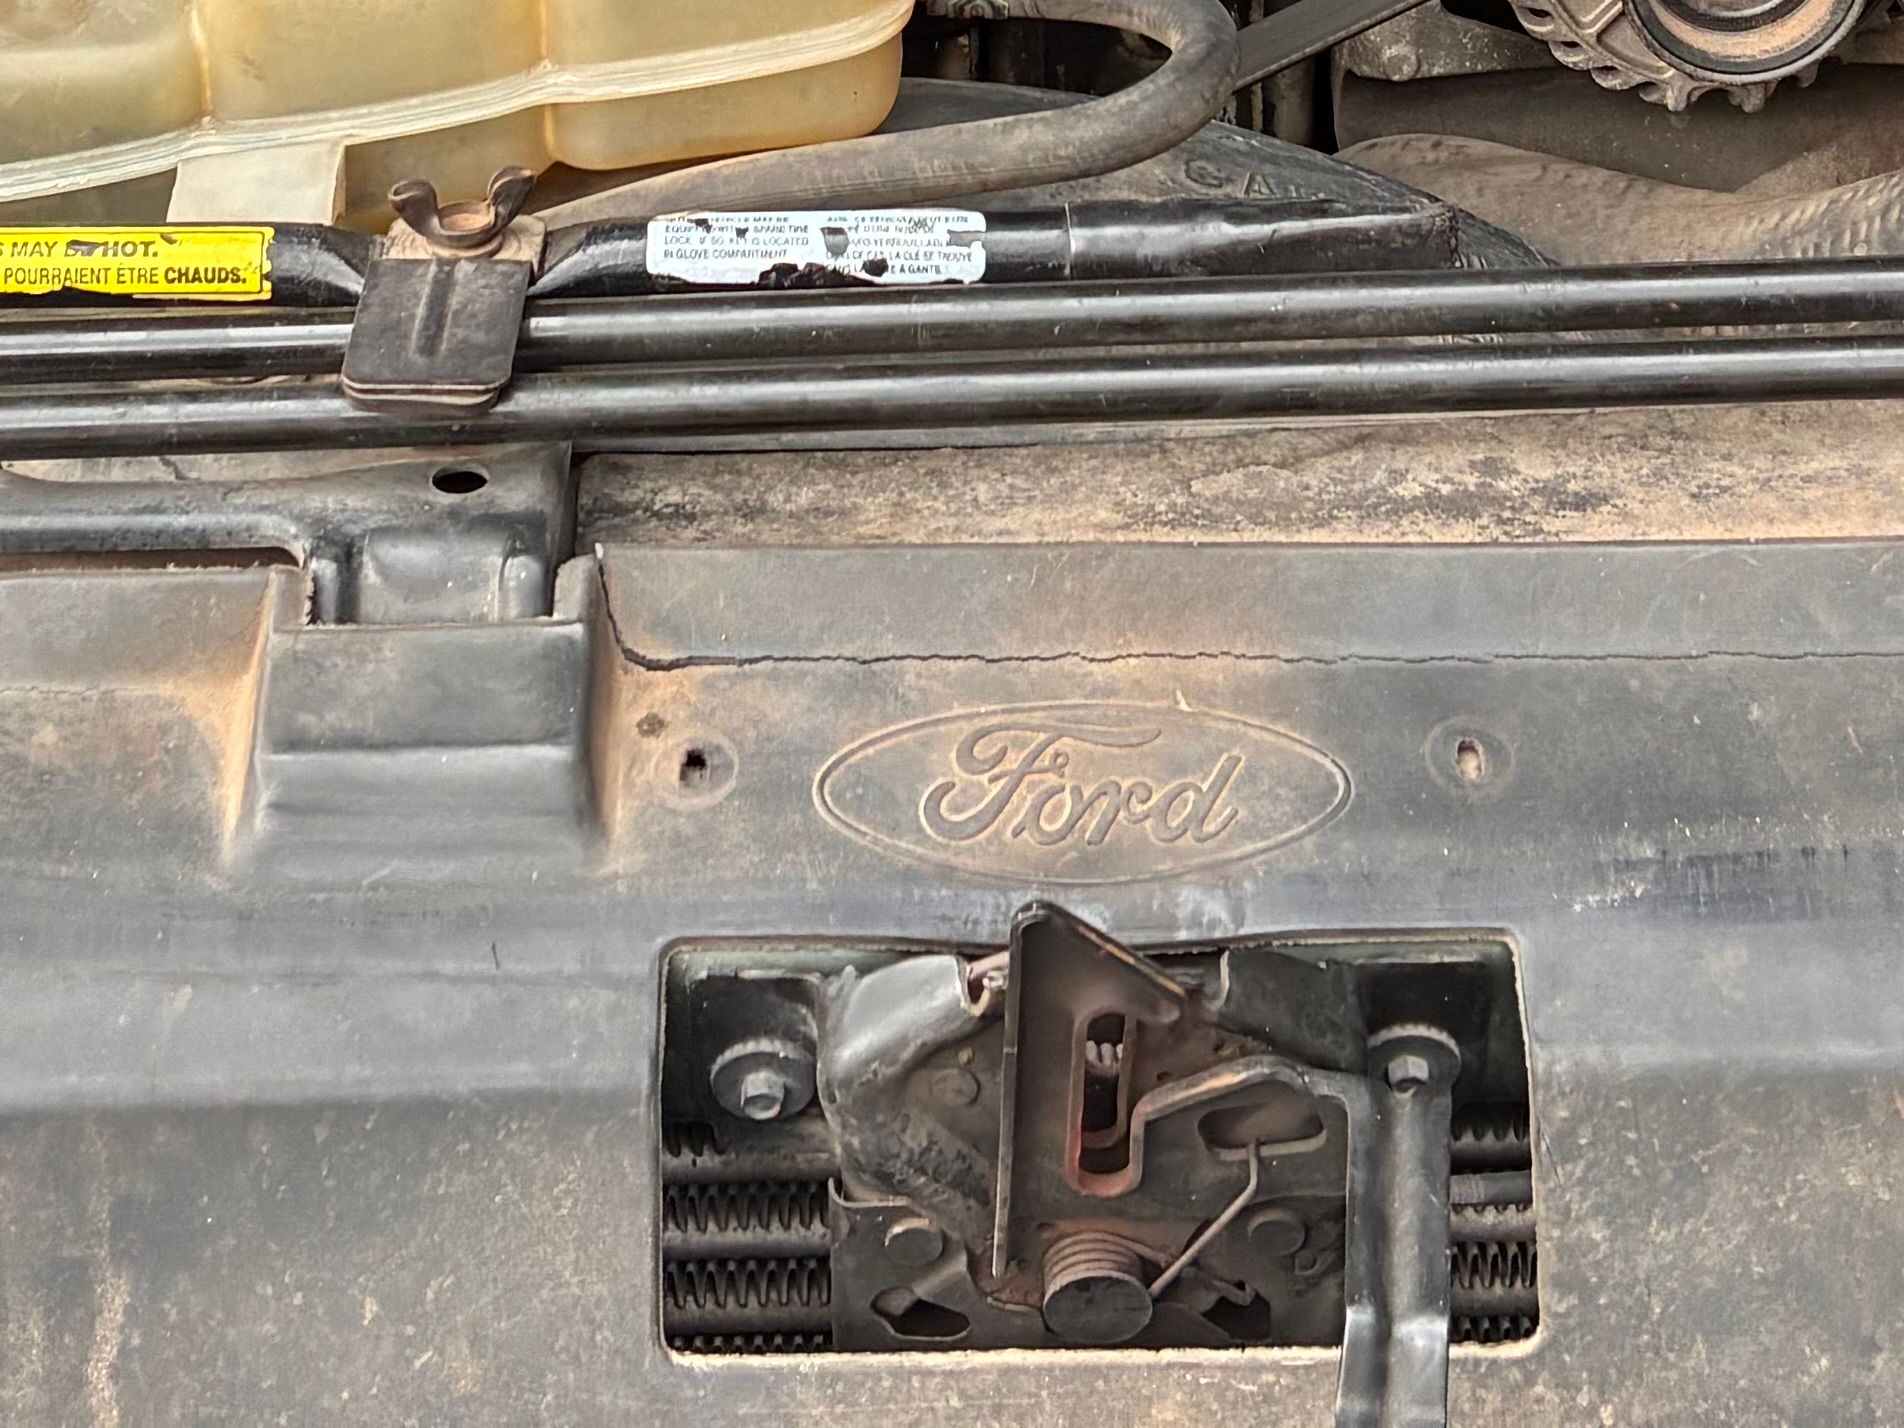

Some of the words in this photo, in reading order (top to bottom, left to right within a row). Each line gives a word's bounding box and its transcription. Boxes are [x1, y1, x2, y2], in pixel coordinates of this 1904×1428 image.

[10, 241, 58, 258] MAY
[99, 241, 160, 258] HOT.
[4, 266, 111, 285] POURRAIENT
[164, 265, 247, 285] CHAUDS.
[919, 722, 1246, 847] Ford
